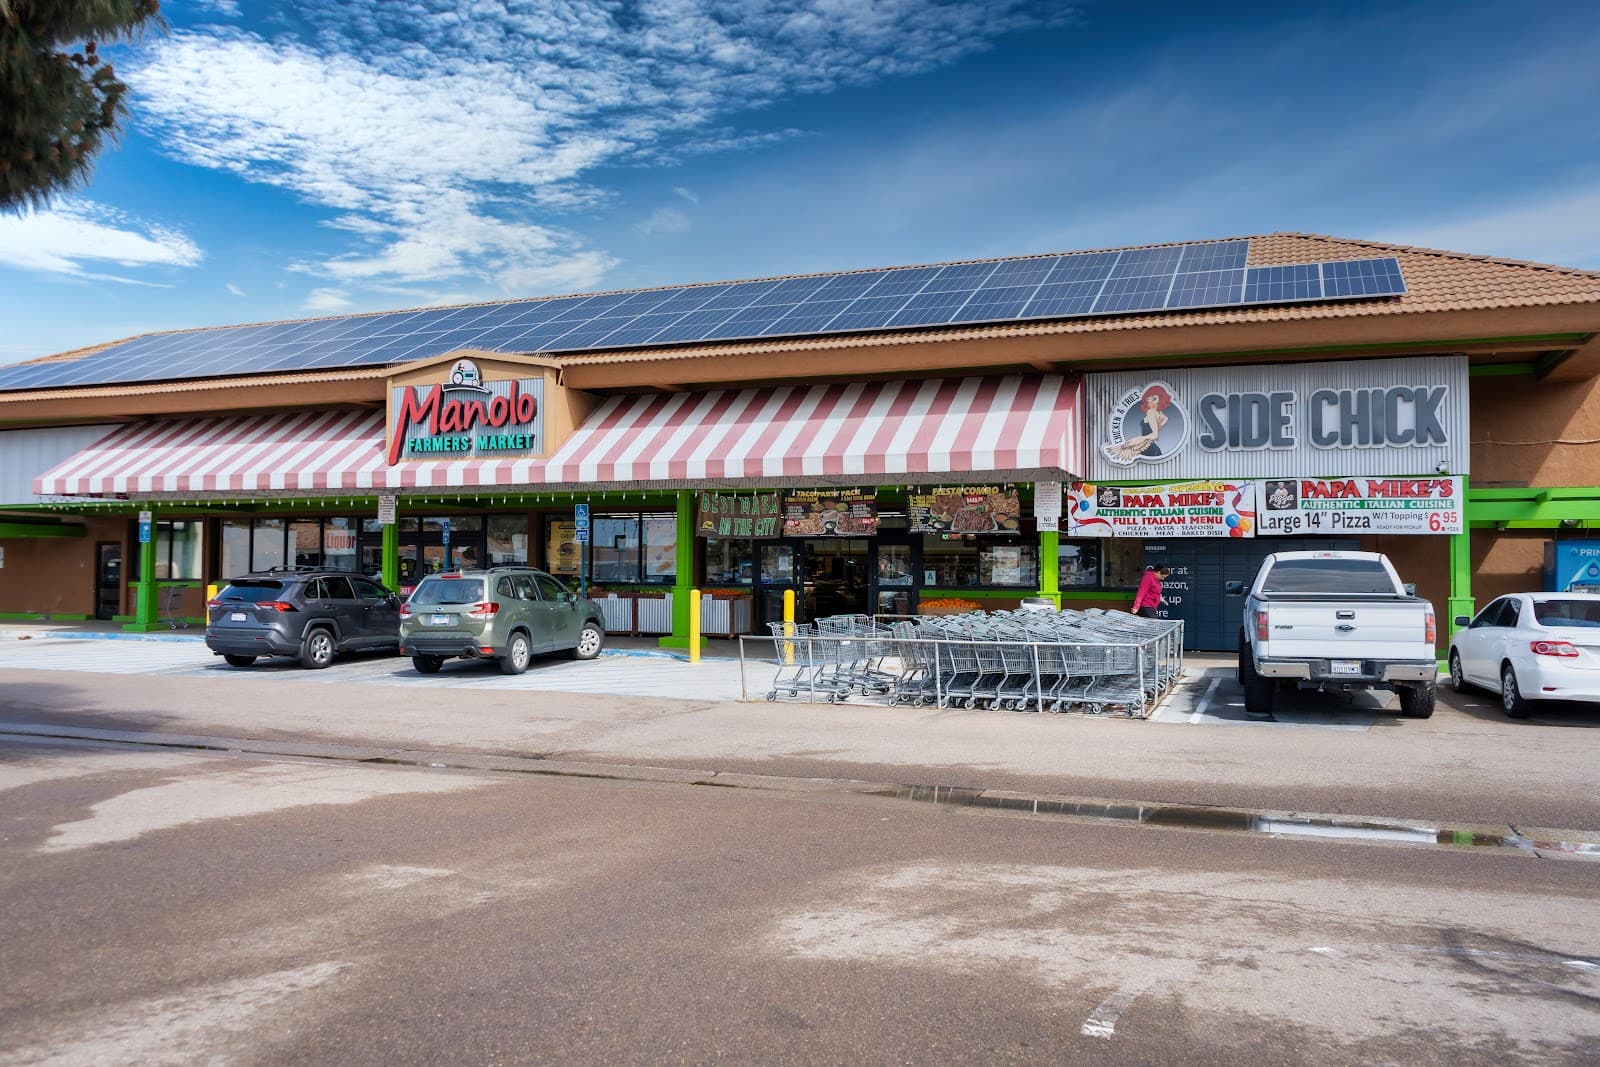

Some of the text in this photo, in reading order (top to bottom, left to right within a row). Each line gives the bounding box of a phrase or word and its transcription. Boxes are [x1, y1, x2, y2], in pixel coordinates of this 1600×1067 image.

[389, 379, 535, 466] Manolo
[1112, 416, 1123, 444] CHICKEN
[1121, 391, 1140, 408] FRIES
[1199, 385, 1448, 449] SIDE CHICK
[408, 433, 533, 452] FARMERS MARKET
[840, 489, 861, 497] PACK
[932, 486, 999, 496] FIESTA COMBO
[1168, 481, 1225, 493] OPENING
[1301, 479, 1453, 499] PAPA MIKE'S
[701, 493, 735, 515] BEST
[738, 495, 778, 515] MASA
[1122, 494, 1165, 508] PAPA
[1168, 492, 1225, 507] MIKE'S
[1302, 500, 1361, 509] AUTHENTIC
[1364, 500, 1405, 509] ITALIAN
[1409, 500, 1453, 508] CUISINE
[1095, 507, 1224, 517] AUTHENTIC ITALIAN CUISINE
[1372, 512, 1388, 520] W/1
[1390, 512, 1423, 521] Topping
[719, 517, 777, 536] IN THE CITY
[1112, 516, 1223, 525] FULL ITALIAN MENU
[1259, 512, 1302, 533] Large
[1331, 511, 1371, 529] Pizza
[325, 533, 356, 550] Liquor
[1177, 566, 1189, 575] at
[1168, 595, 1182, 606] up
